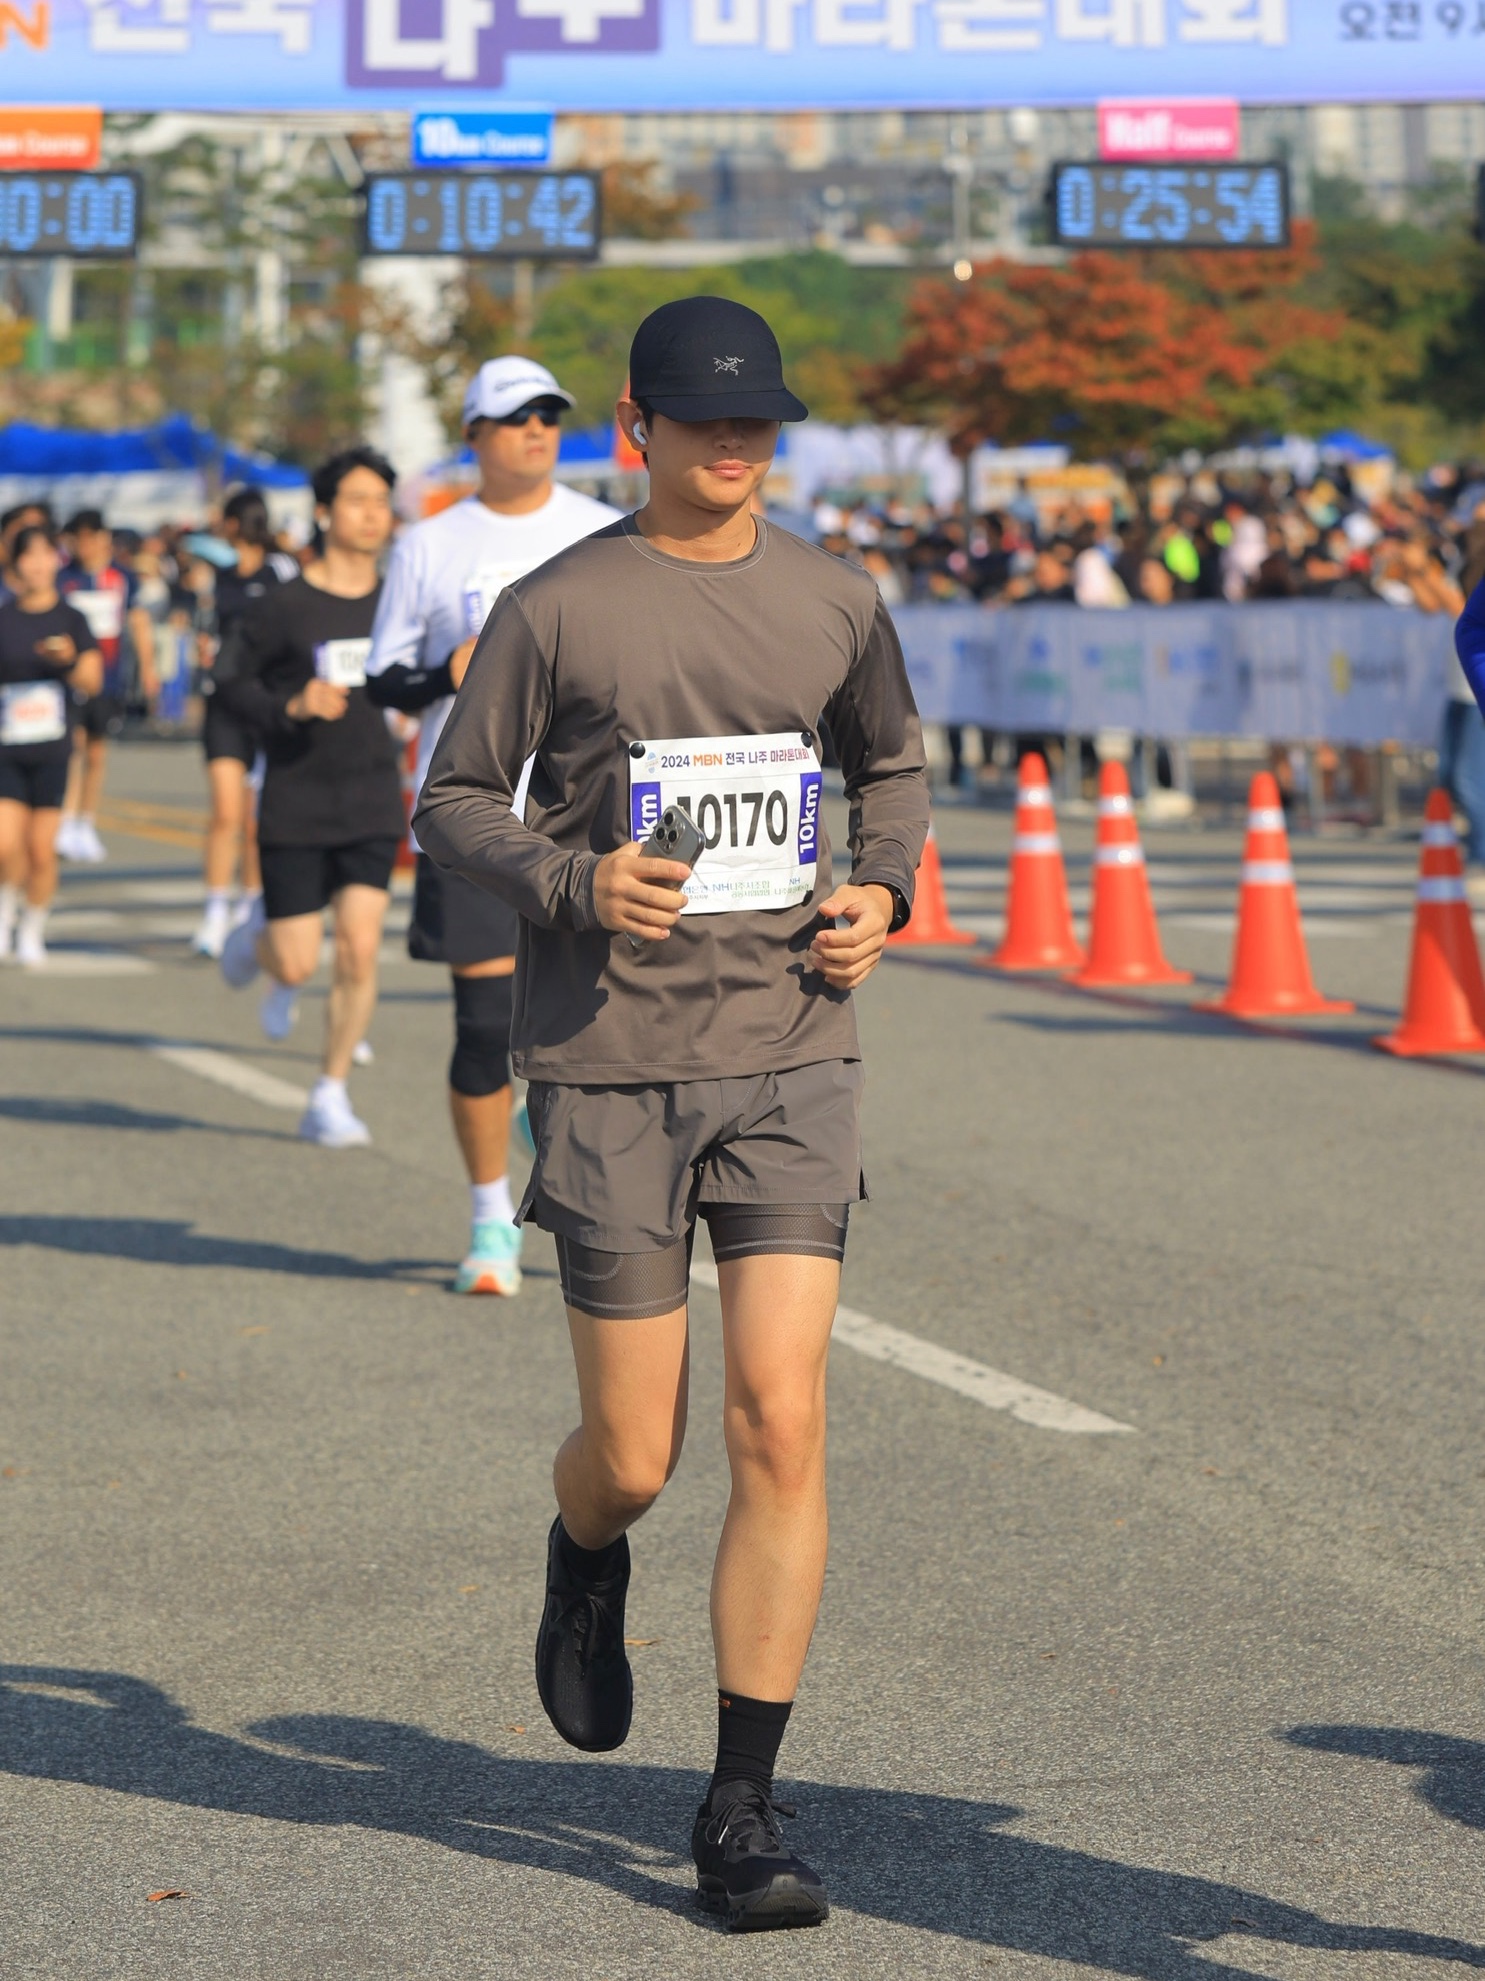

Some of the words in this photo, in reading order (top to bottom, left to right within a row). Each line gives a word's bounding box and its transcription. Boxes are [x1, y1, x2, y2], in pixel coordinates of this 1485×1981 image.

[369, 175, 596, 251] 0:10:42
[1056, 166, 1282, 243] 0:25:54
[661, 755, 691, 768] 2024
[693, 754, 723, 767] MBN
[725, 752, 745, 766] 전국
[749, 751, 767, 764] 나주
[770, 748, 810, 763] 마라톤대회
[799, 783, 819, 853] 10km
